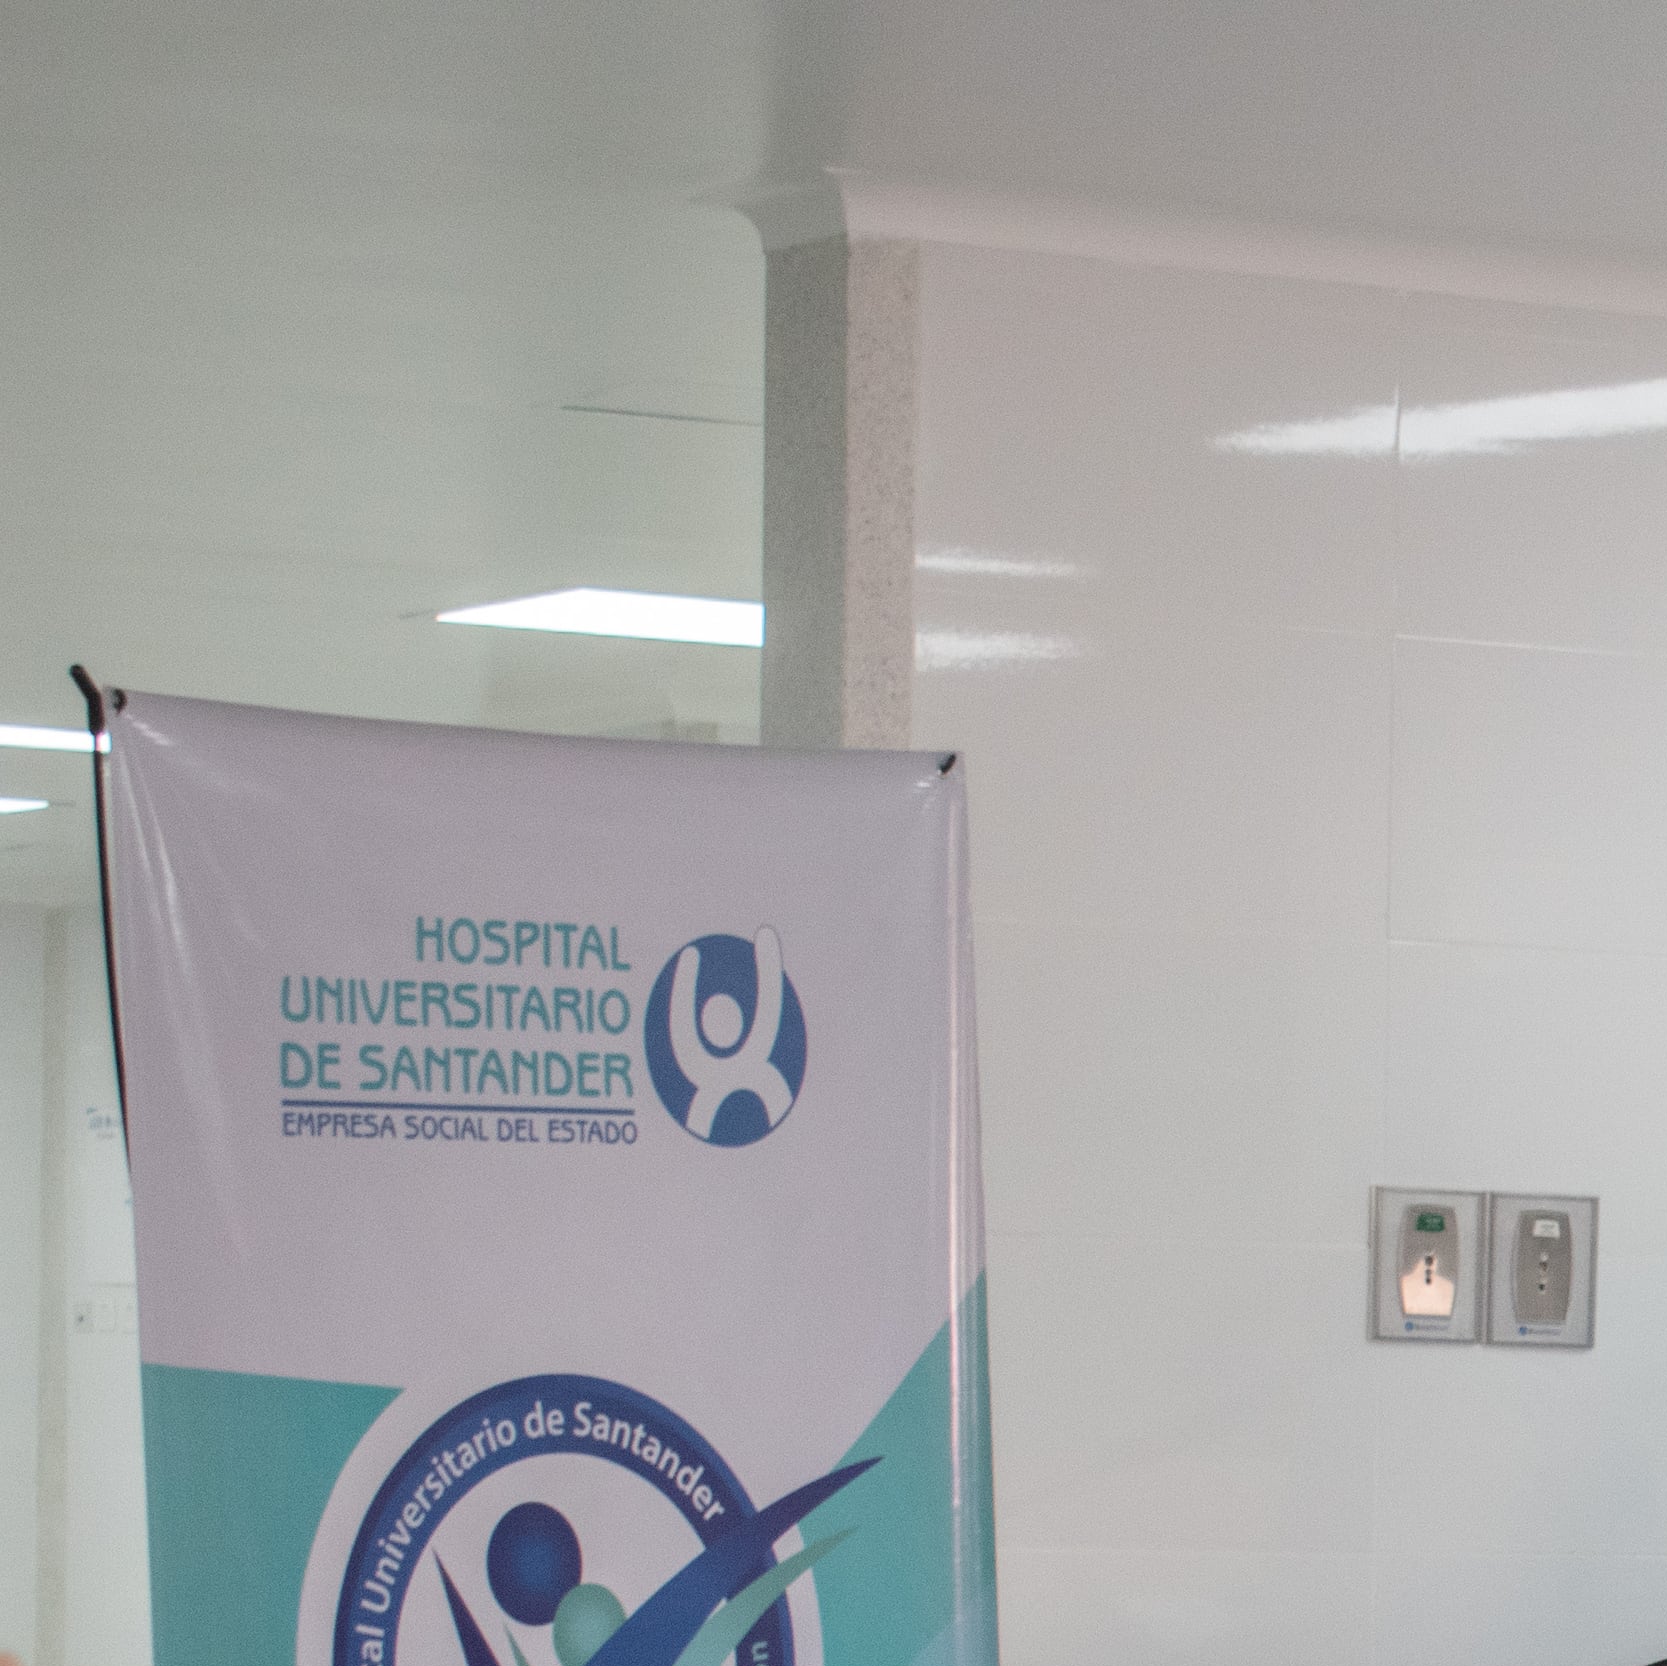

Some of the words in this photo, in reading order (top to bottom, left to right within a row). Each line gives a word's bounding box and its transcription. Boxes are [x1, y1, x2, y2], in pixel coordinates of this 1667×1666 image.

[416, 916, 631, 971] HOSPITAL
[280, 976, 631, 1035] UNIVERSITARIO
[280, 1042, 341, 1090] DE
[358, 1044, 634, 1098] SANTANDER
[282, 1112, 397, 1139] EMPRESA
[404, 1116, 489, 1142] SOCIAL
[497, 1118, 539, 1143] DEL
[547, 1119, 638, 1145] ESTADO
[362, 1417, 516, 1615] Universitario
[524, 1400, 565, 1439] de
[573, 1402, 726, 1522] Santander
